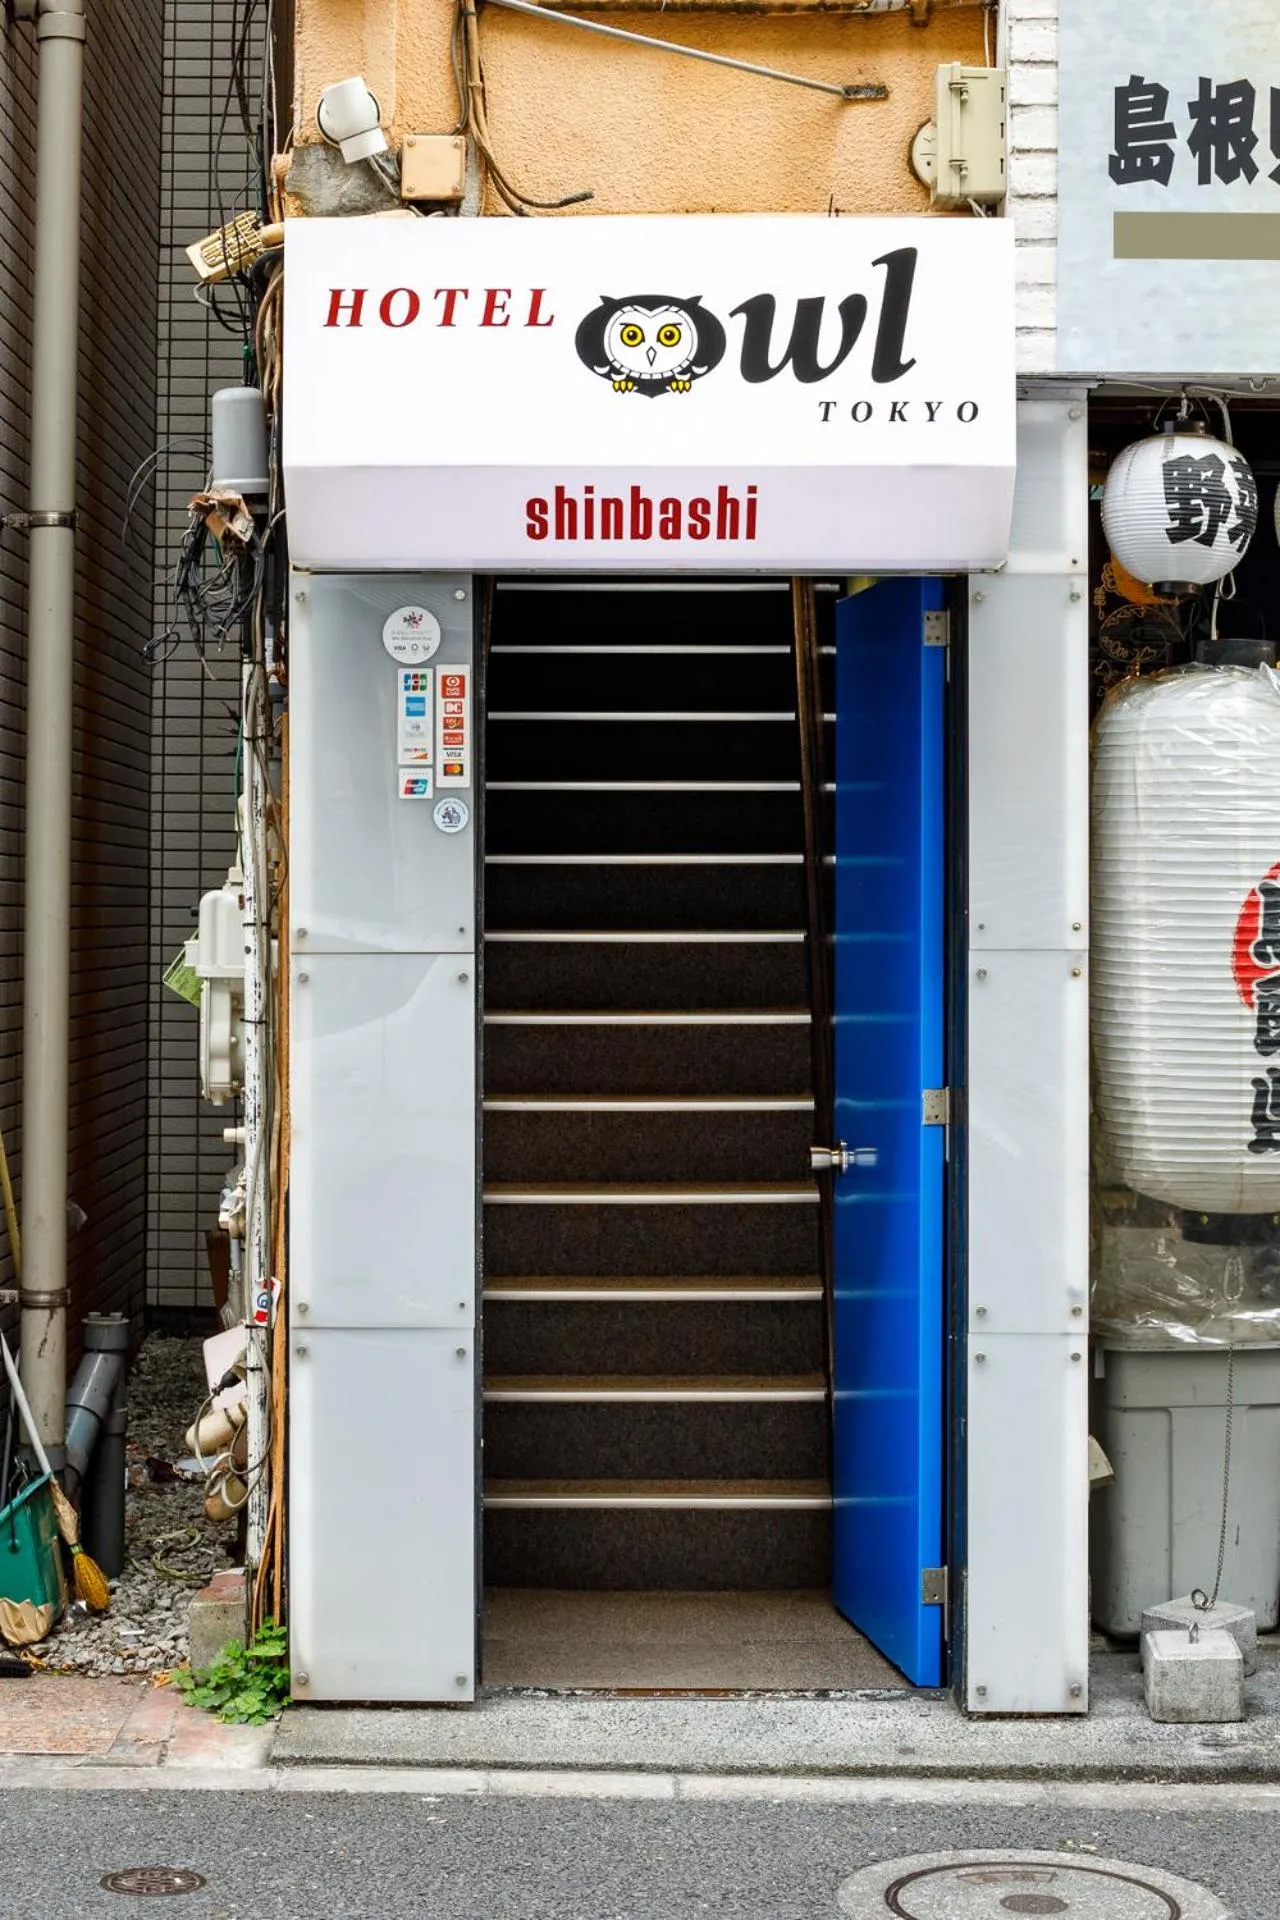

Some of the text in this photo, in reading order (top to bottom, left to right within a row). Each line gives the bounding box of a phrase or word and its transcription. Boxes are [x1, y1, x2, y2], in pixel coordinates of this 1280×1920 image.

[1109, 75, 1280, 186] 島根
[323, 287, 556, 327] HOTEL
[819, 400, 981, 423] TOKYO
[526, 485, 758, 541] shinbashi
